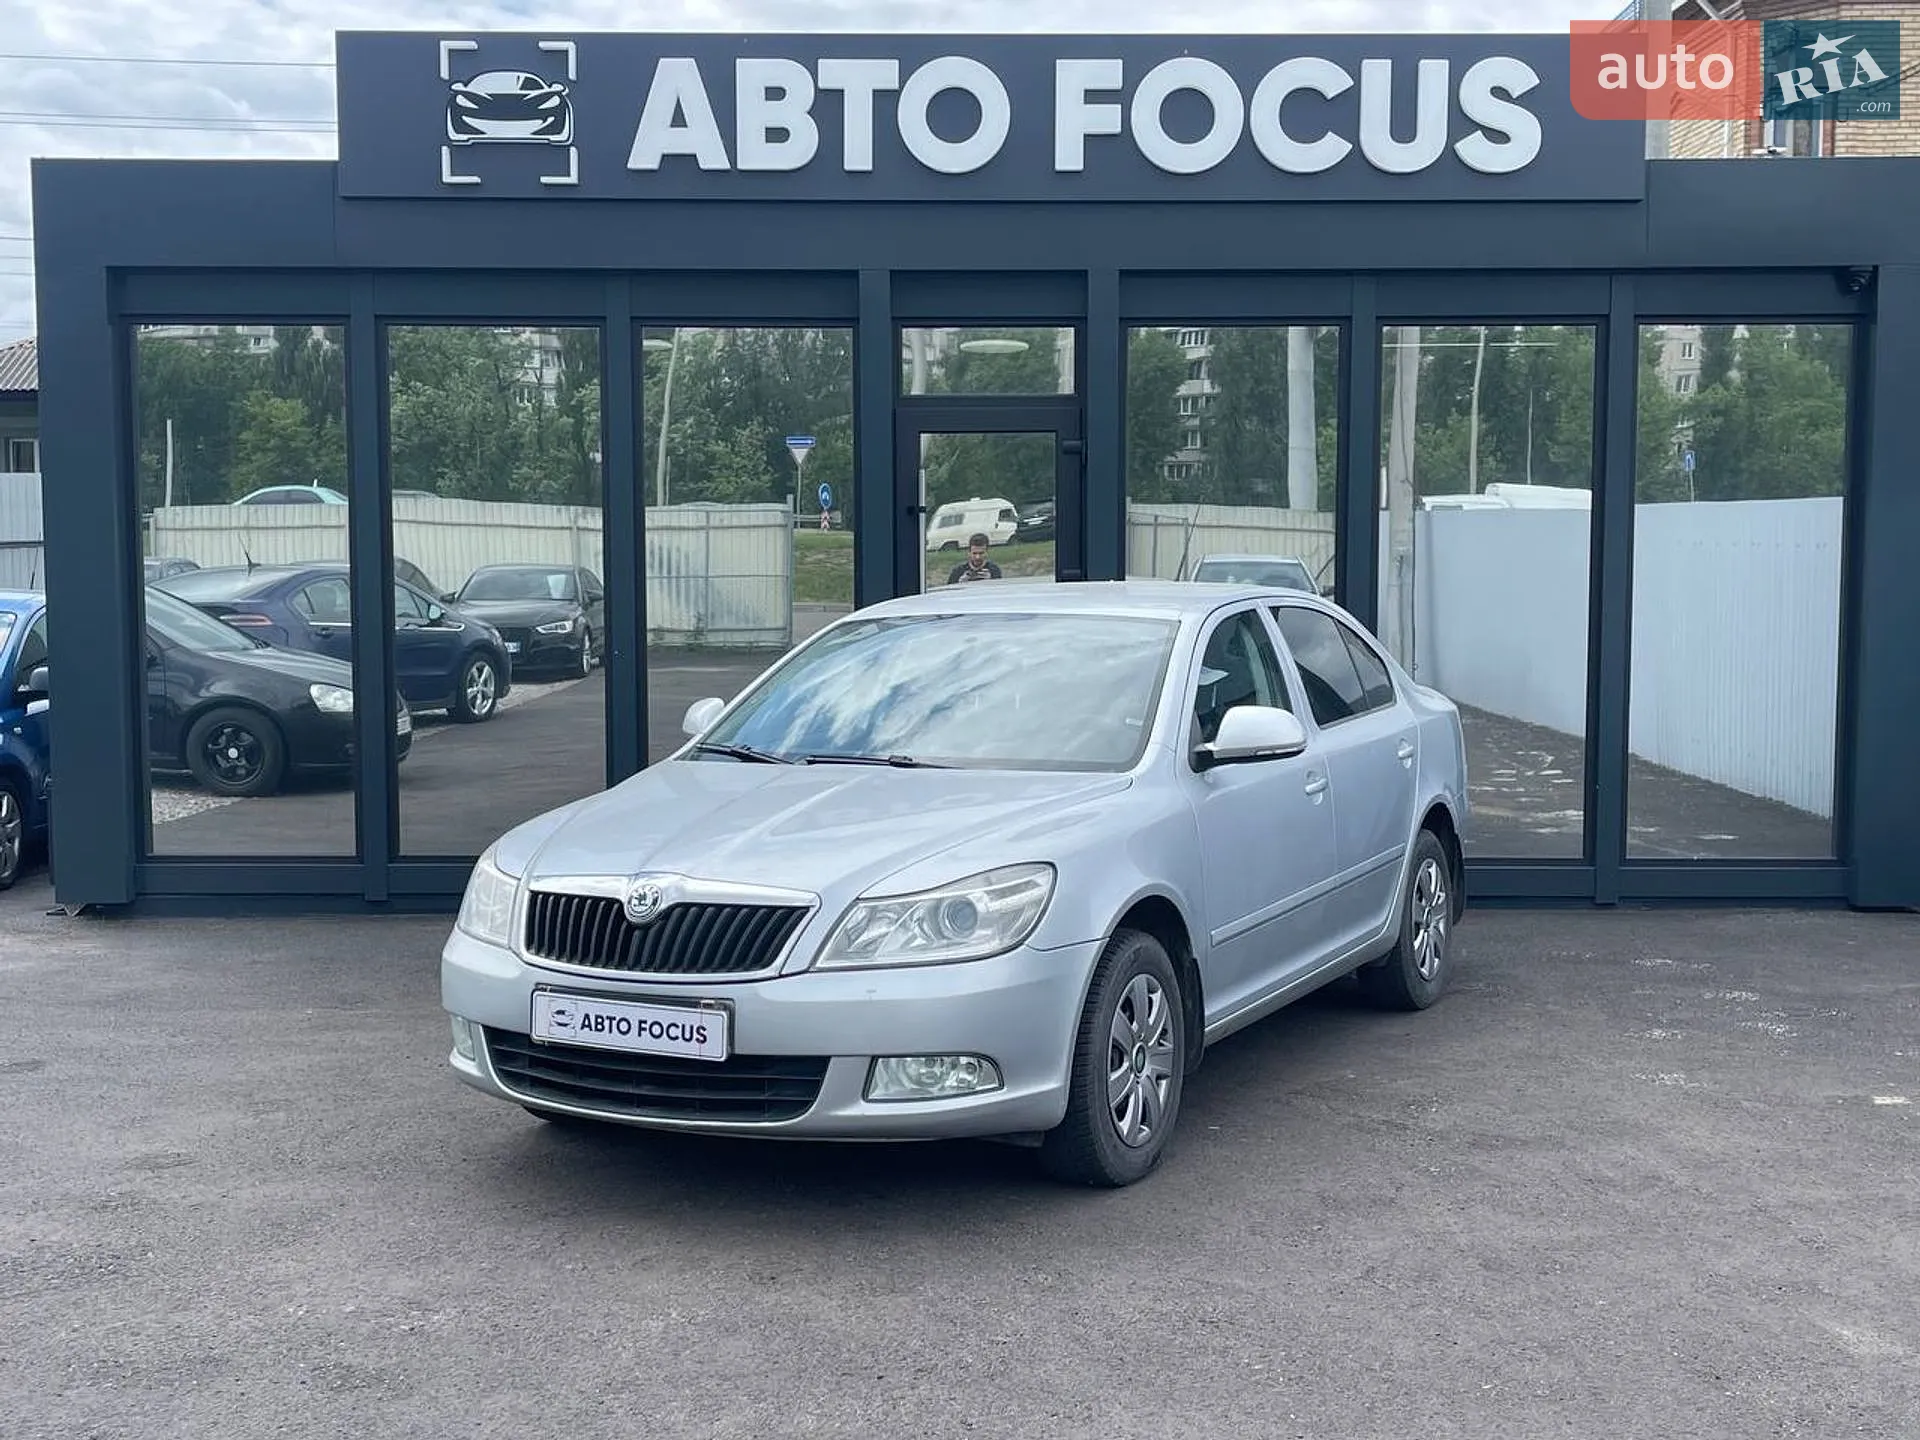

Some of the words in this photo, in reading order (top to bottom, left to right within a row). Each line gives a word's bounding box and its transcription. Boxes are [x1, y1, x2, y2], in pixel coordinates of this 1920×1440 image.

[627, 56, 1011, 174] АВТО
[1054, 56, 1542, 174] FOCUS
[580, 1013, 632, 1036] АВТО
[637, 1020, 708, 1044] FOCUS
